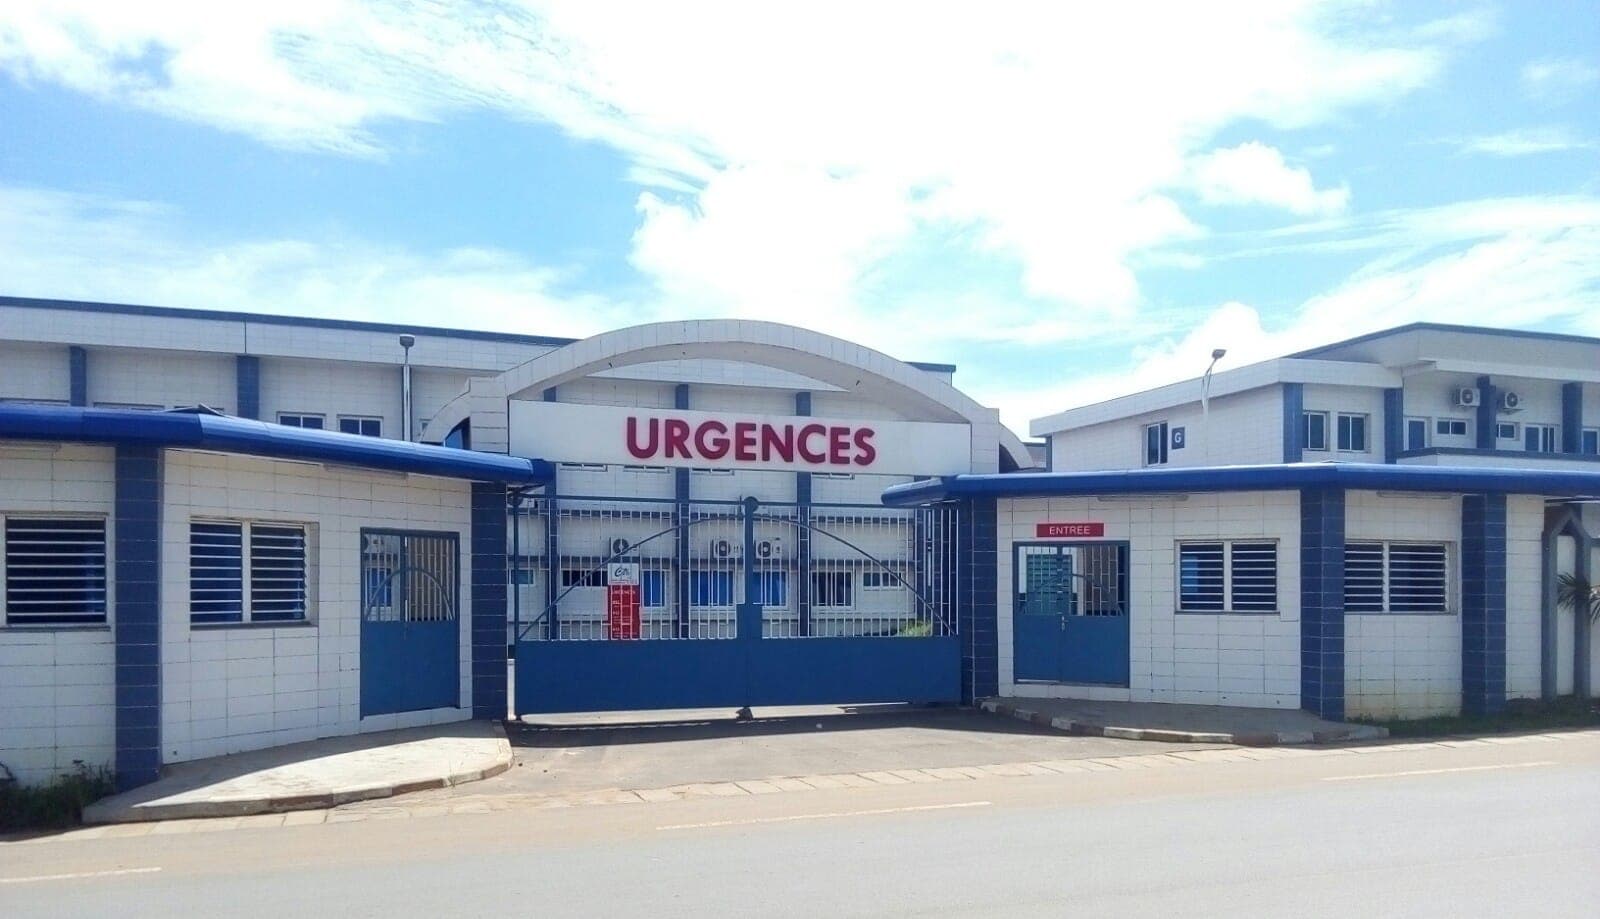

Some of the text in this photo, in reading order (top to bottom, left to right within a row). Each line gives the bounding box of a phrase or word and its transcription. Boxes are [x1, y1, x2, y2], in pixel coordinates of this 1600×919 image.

[626, 417, 876, 466] URGENCES
[1174, 431, 1182, 443] G
[1049, 526, 1091, 535] ENTREE
